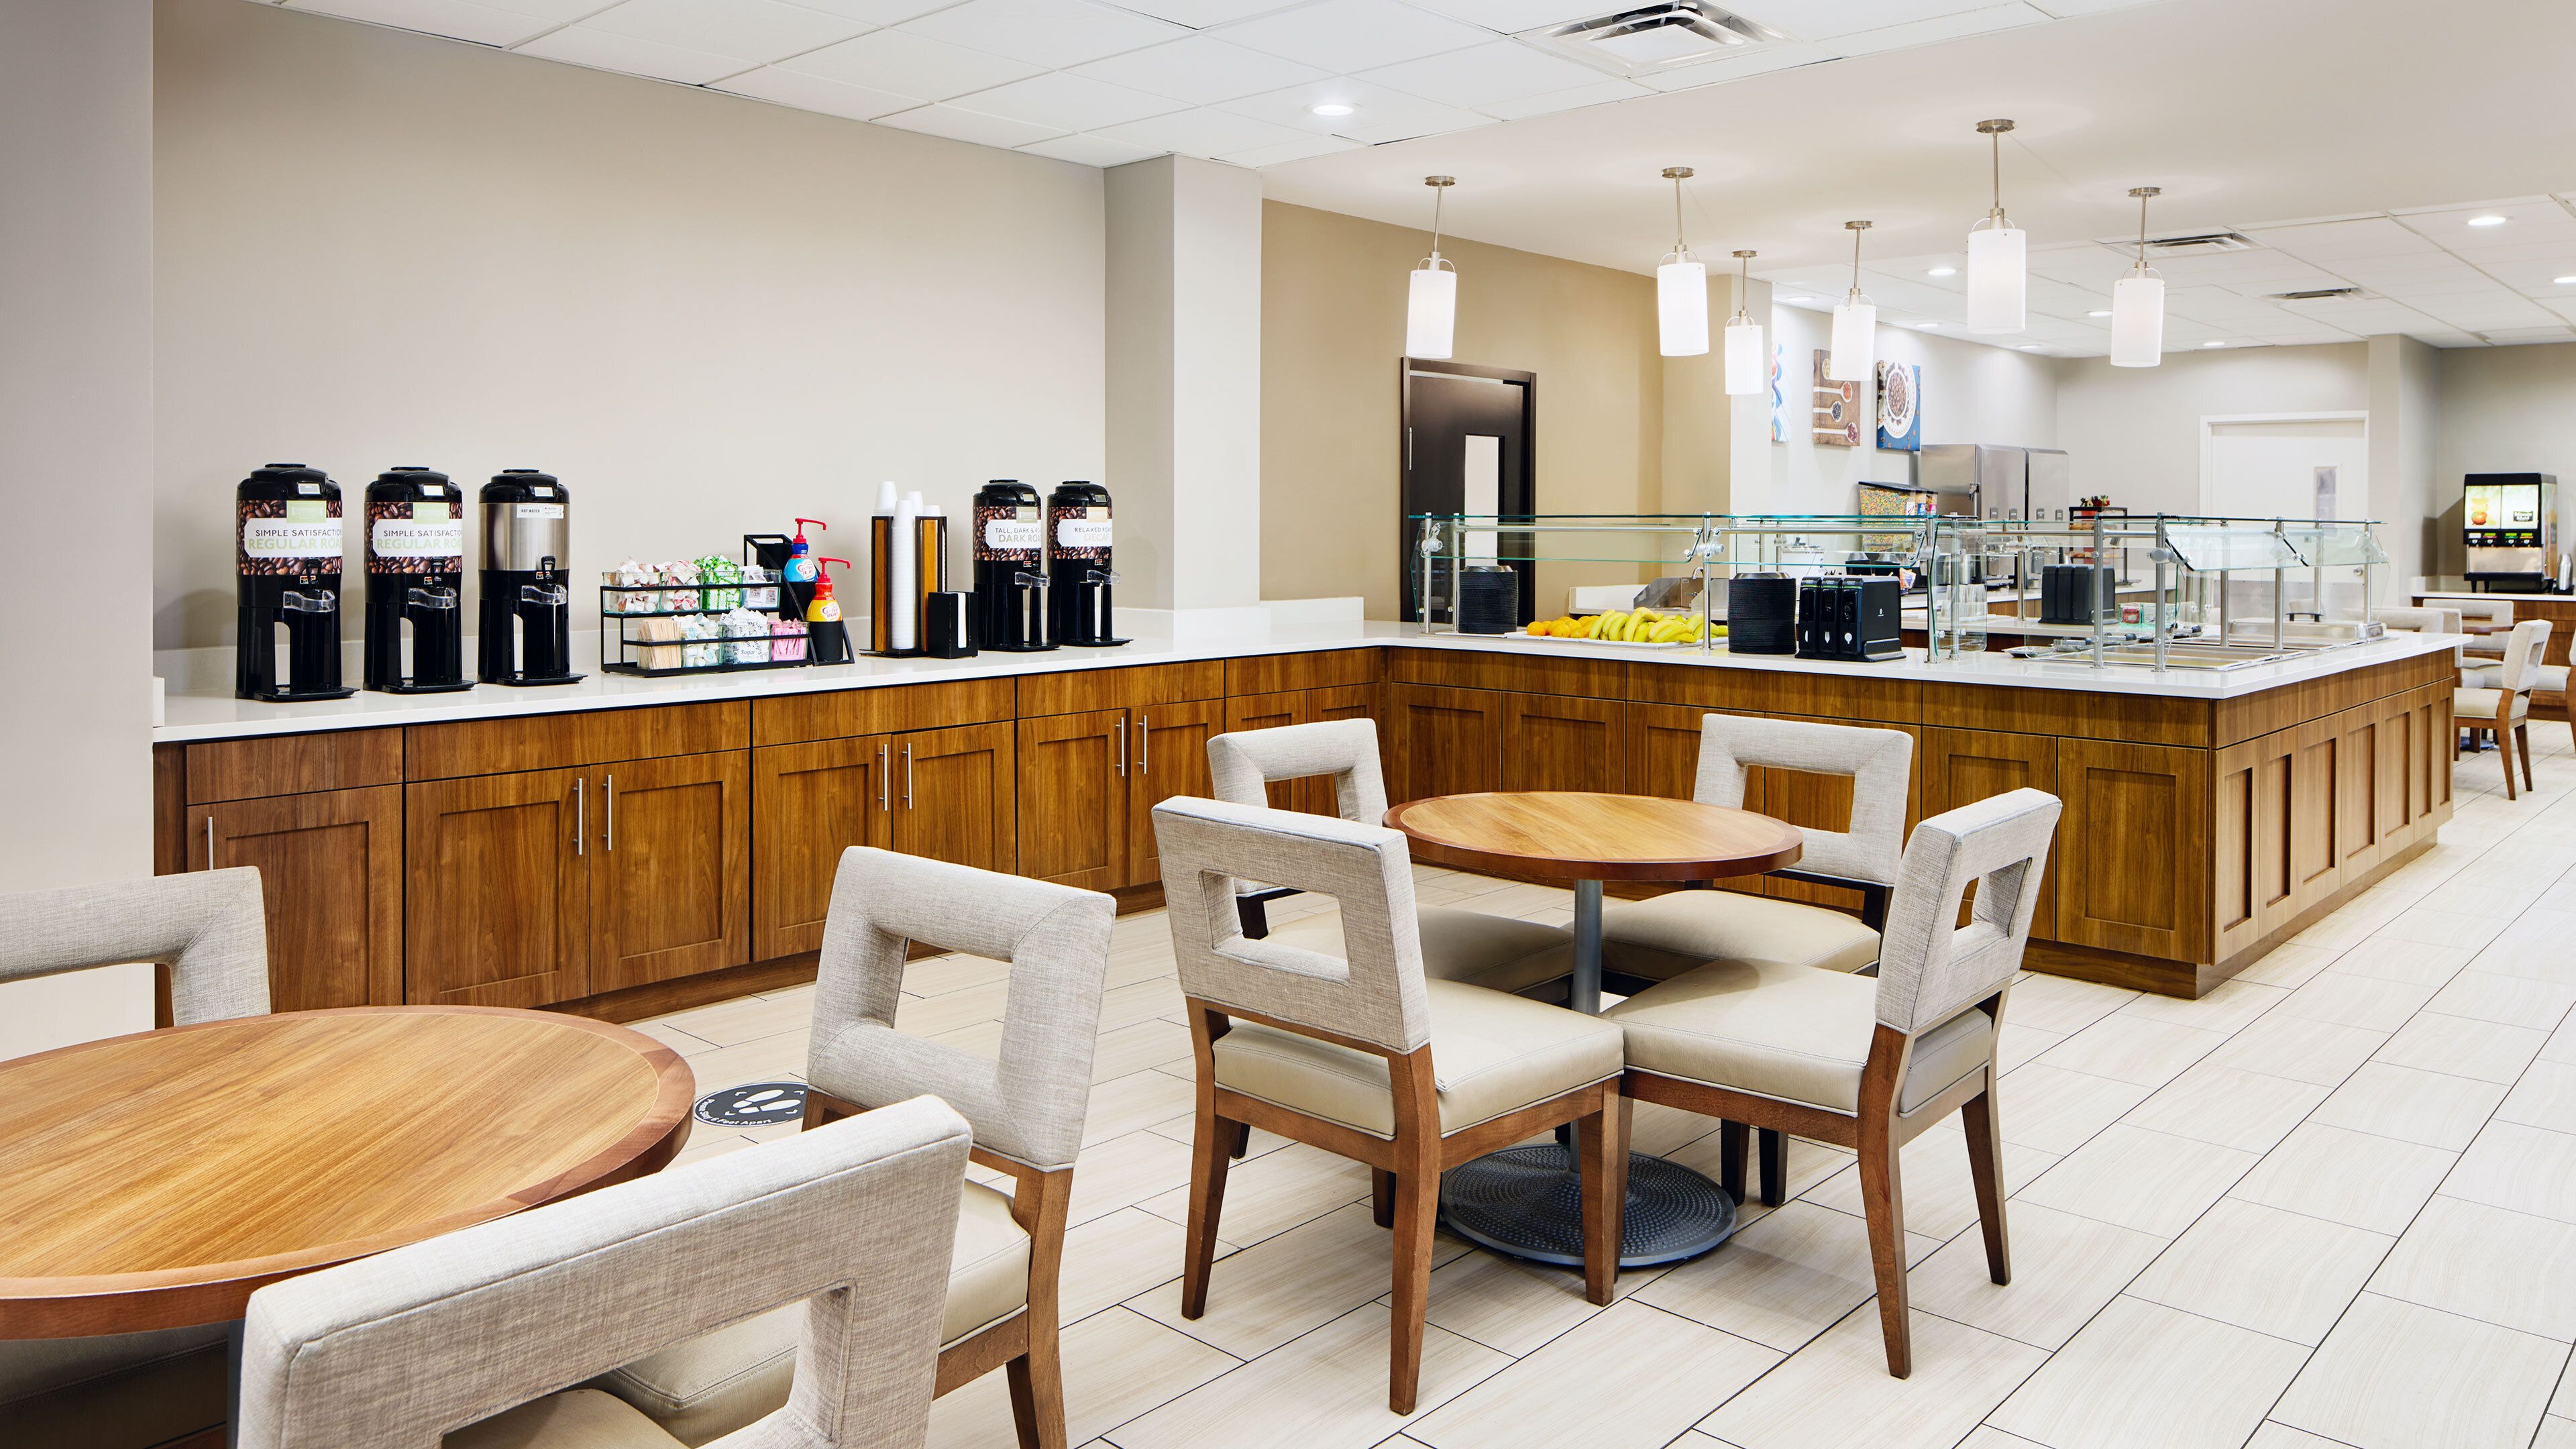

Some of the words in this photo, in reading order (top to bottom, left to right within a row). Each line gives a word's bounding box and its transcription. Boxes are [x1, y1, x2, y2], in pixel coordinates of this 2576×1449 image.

[1084, 533, 1111, 541] DECAF
[248, 538, 318, 549] REGULAR
[376, 538, 441, 549] REGULAR
[700, 1111, 713, 1119] Stay
